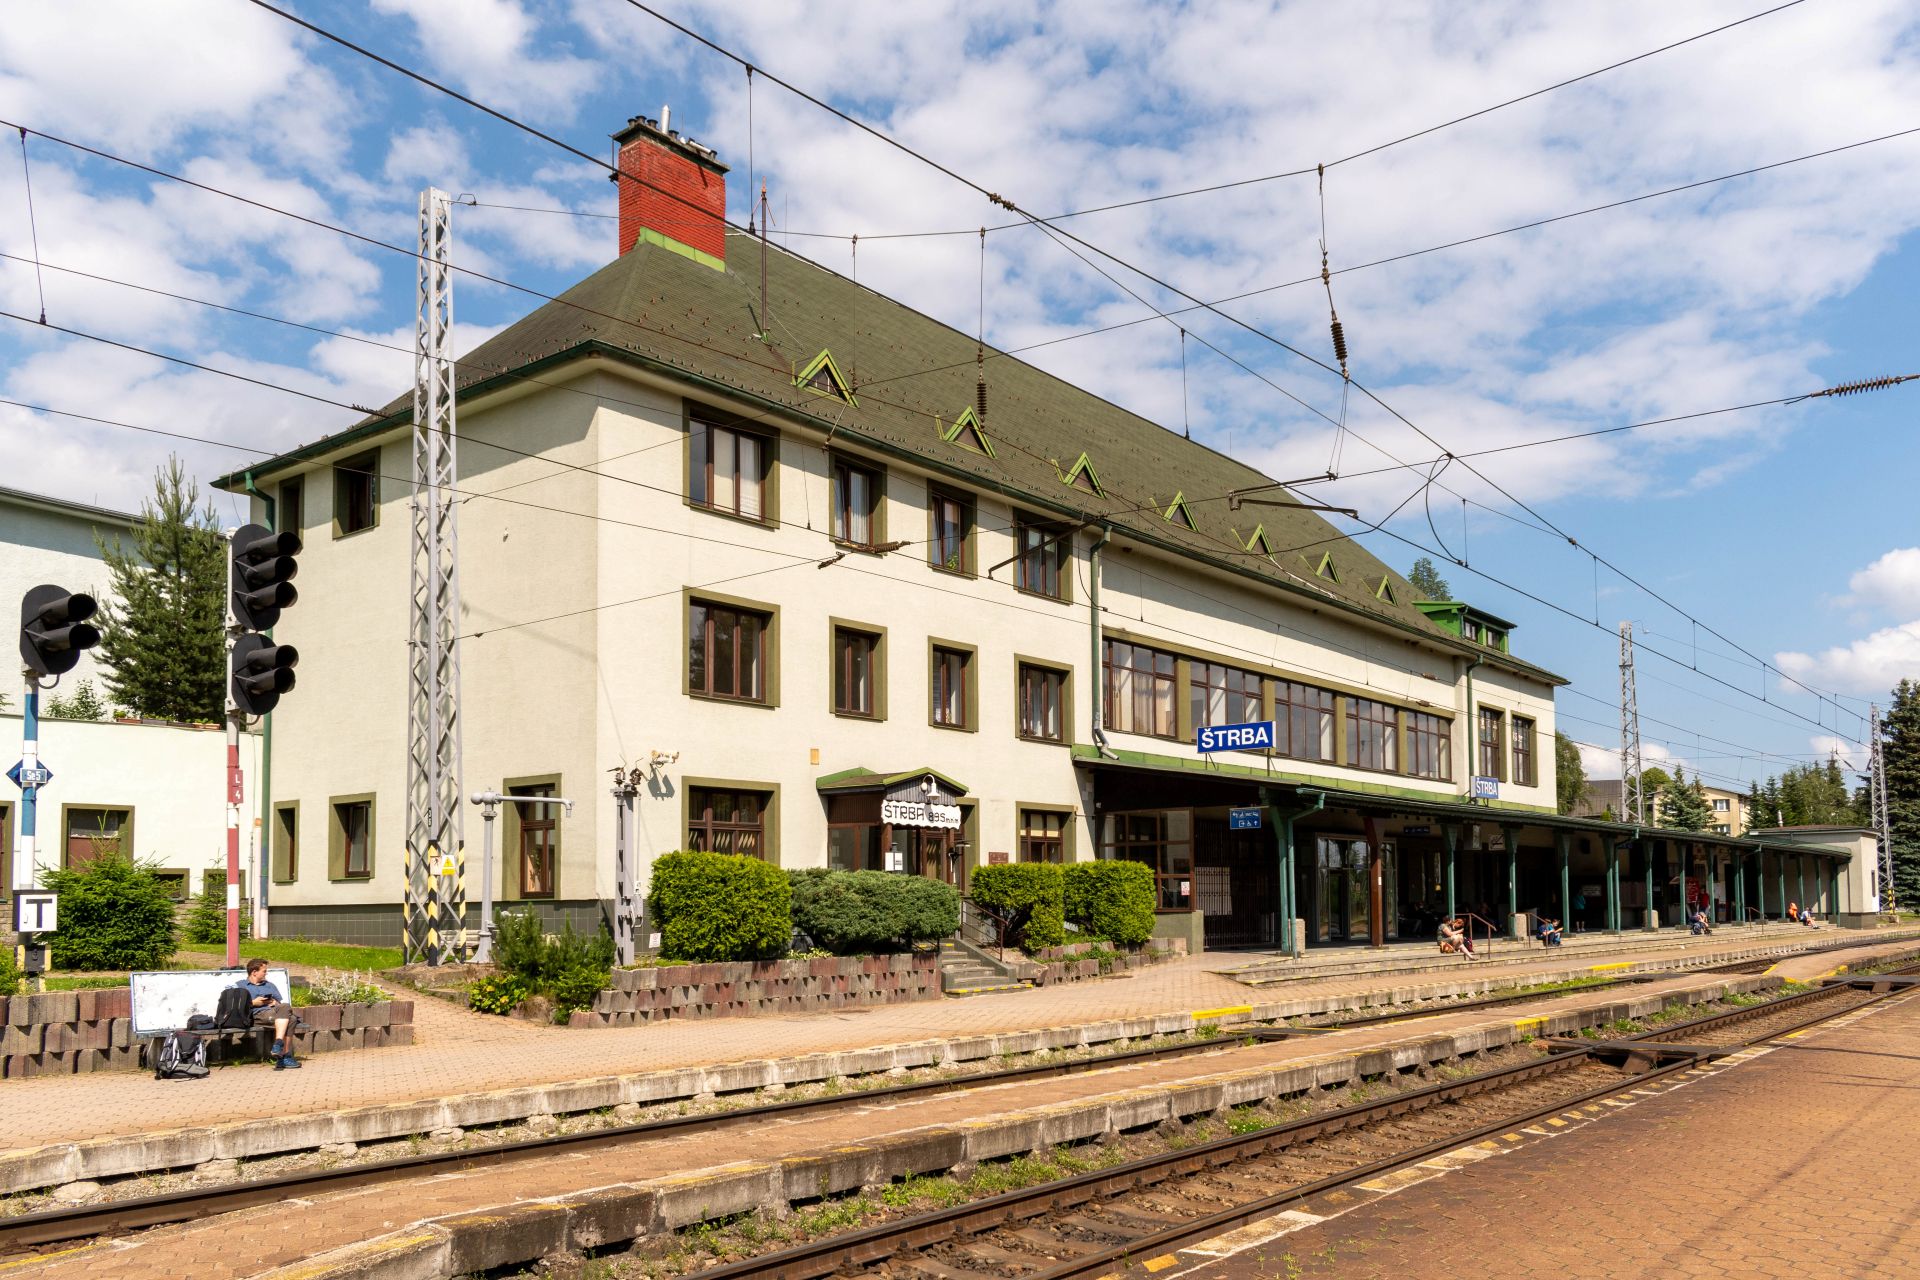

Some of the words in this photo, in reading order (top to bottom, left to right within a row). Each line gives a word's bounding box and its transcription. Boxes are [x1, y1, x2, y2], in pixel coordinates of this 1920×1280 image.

[1201, 726, 1269, 749] ŠTRBA
[1476, 777, 1498, 796] ŠTRBA
[884, 803, 925, 821] ŠTRBA
[26, 898, 53, 928] T
